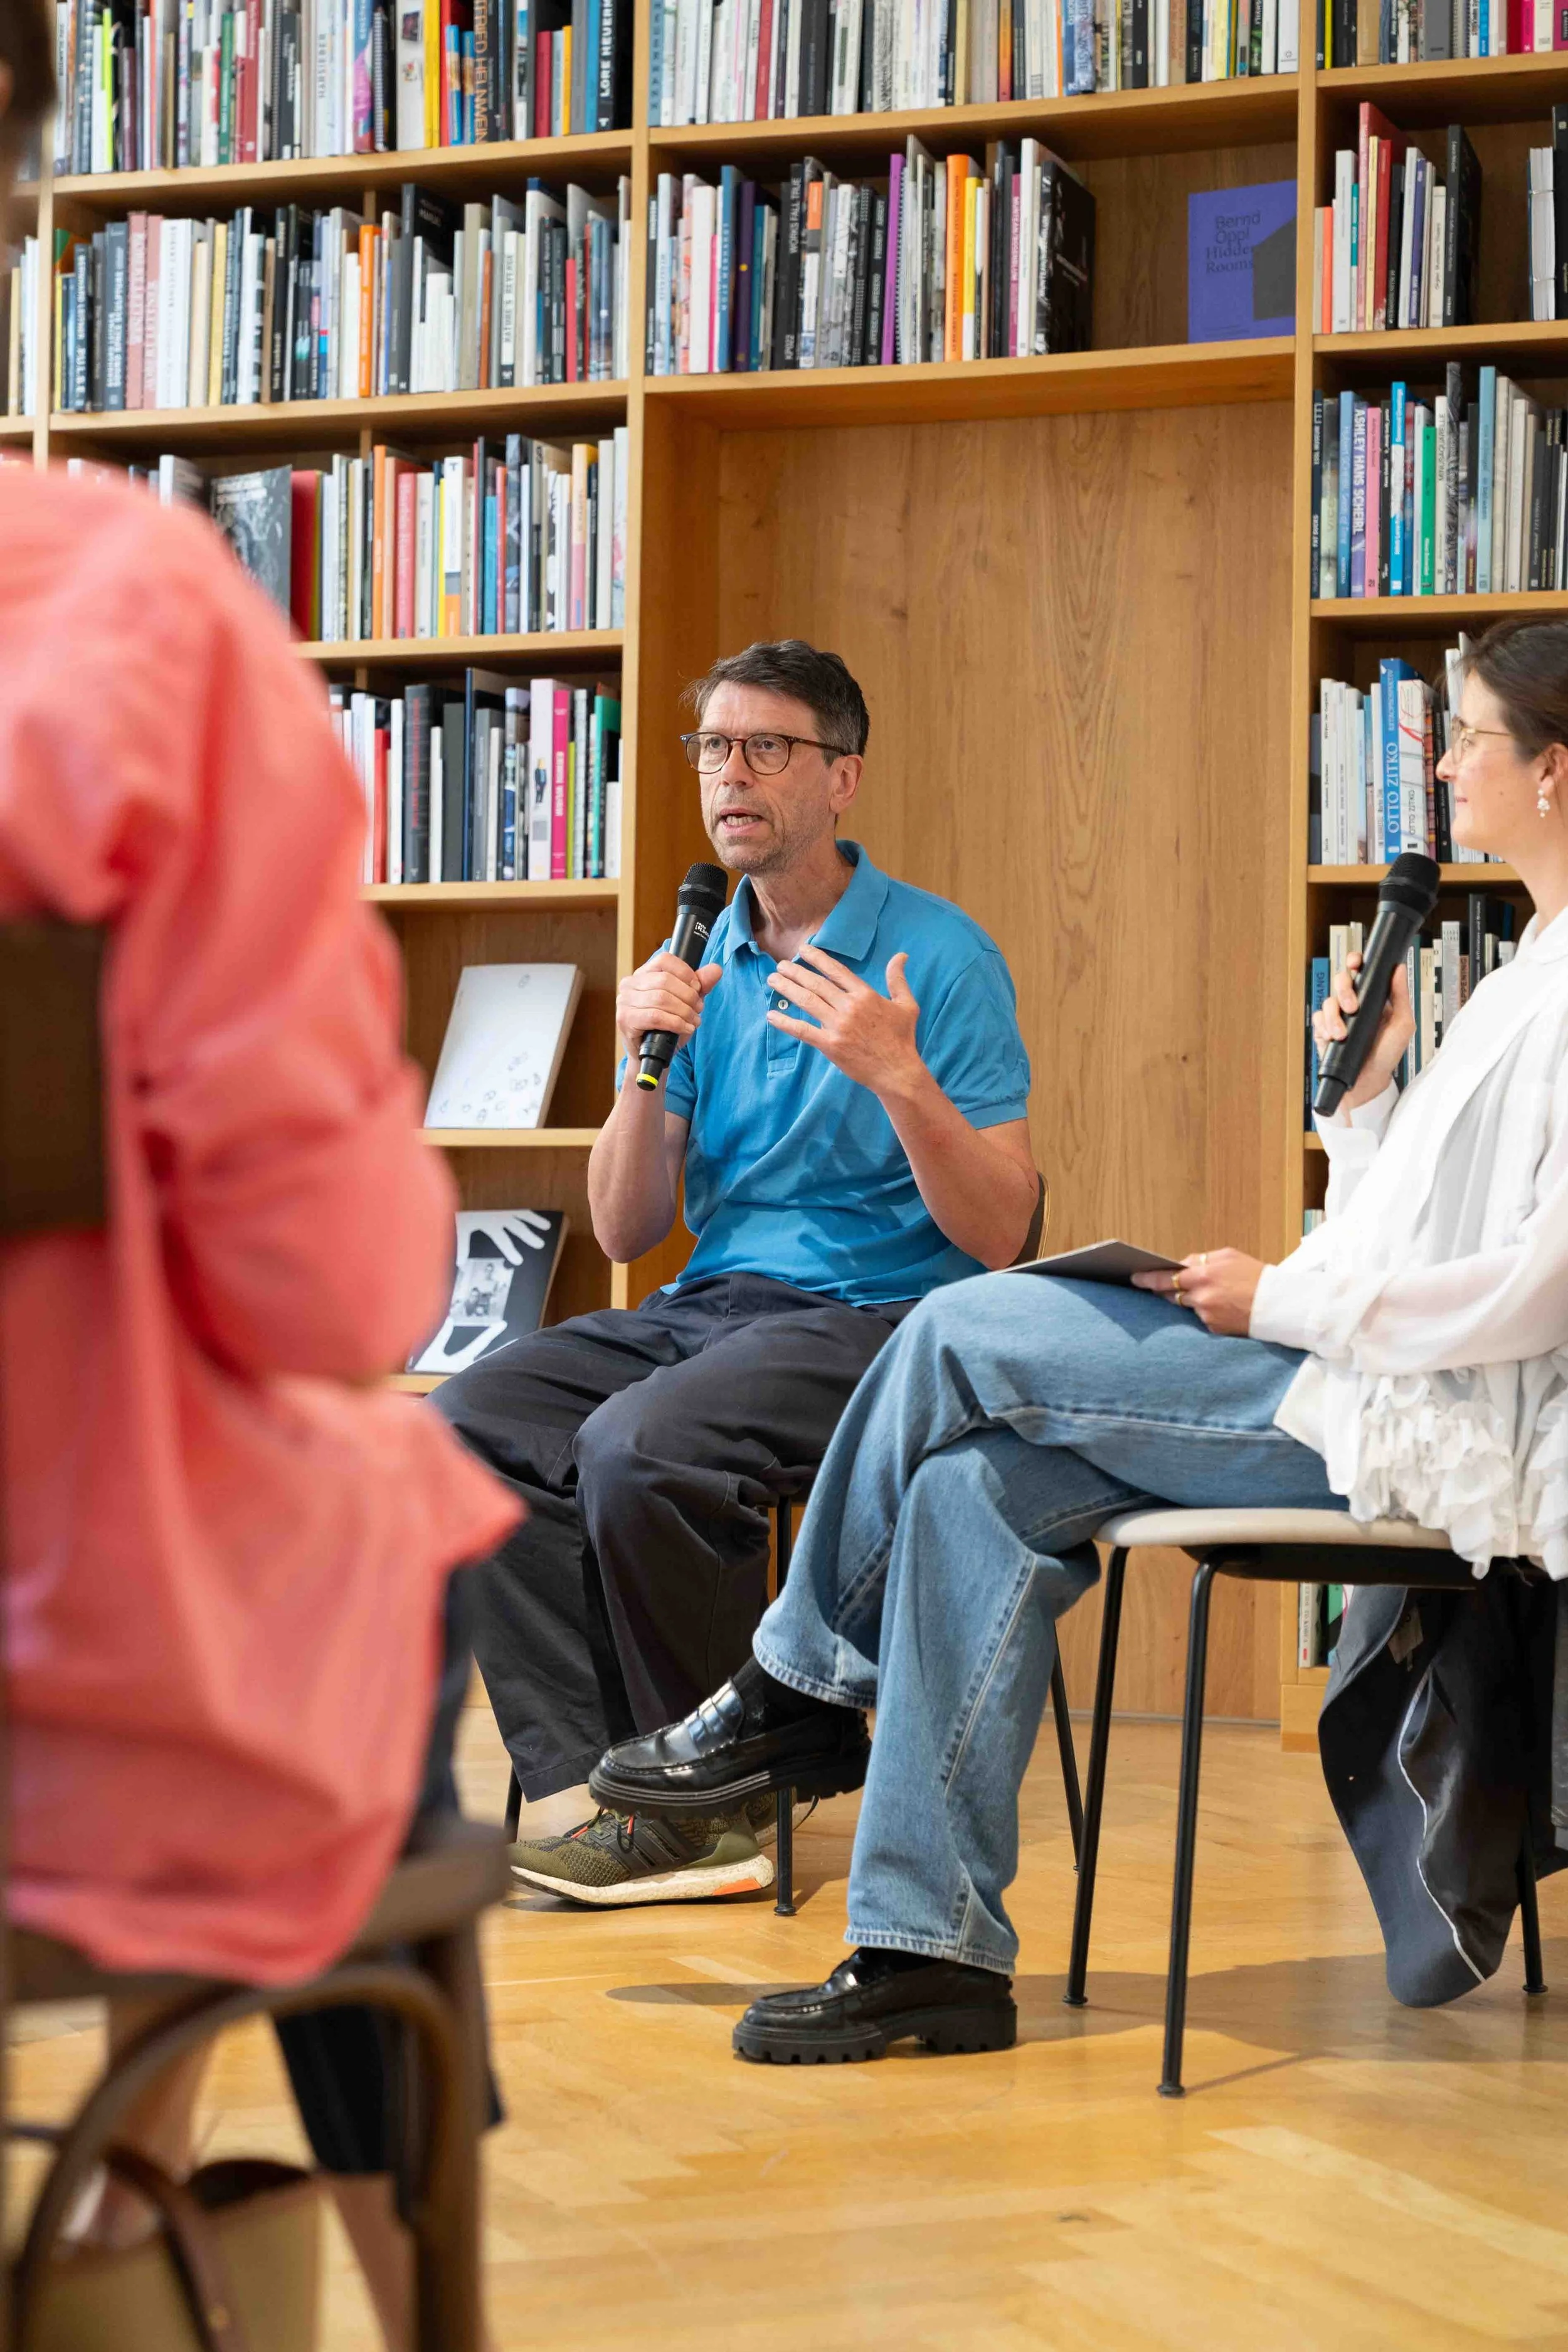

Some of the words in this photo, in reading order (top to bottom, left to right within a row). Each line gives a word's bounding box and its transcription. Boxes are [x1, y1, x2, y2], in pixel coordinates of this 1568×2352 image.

[600, 60, 613, 97] LORE
[1216, 210, 1261, 230] Bernd
[1216, 228, 1251, 246] Oppl
[1205, 245, 1254, 259] Hidde
[1353, 408, 1366, 453] ASHLEY
[1352, 455, 1365, 485] HANS
[1352, 487, 1365, 536] SCHEIRL
[1386, 742, 1399, 787] ZITKO
[1387, 792, 1400, 834] OTTO
[1459, 957, 1468, 1005] APPENING
